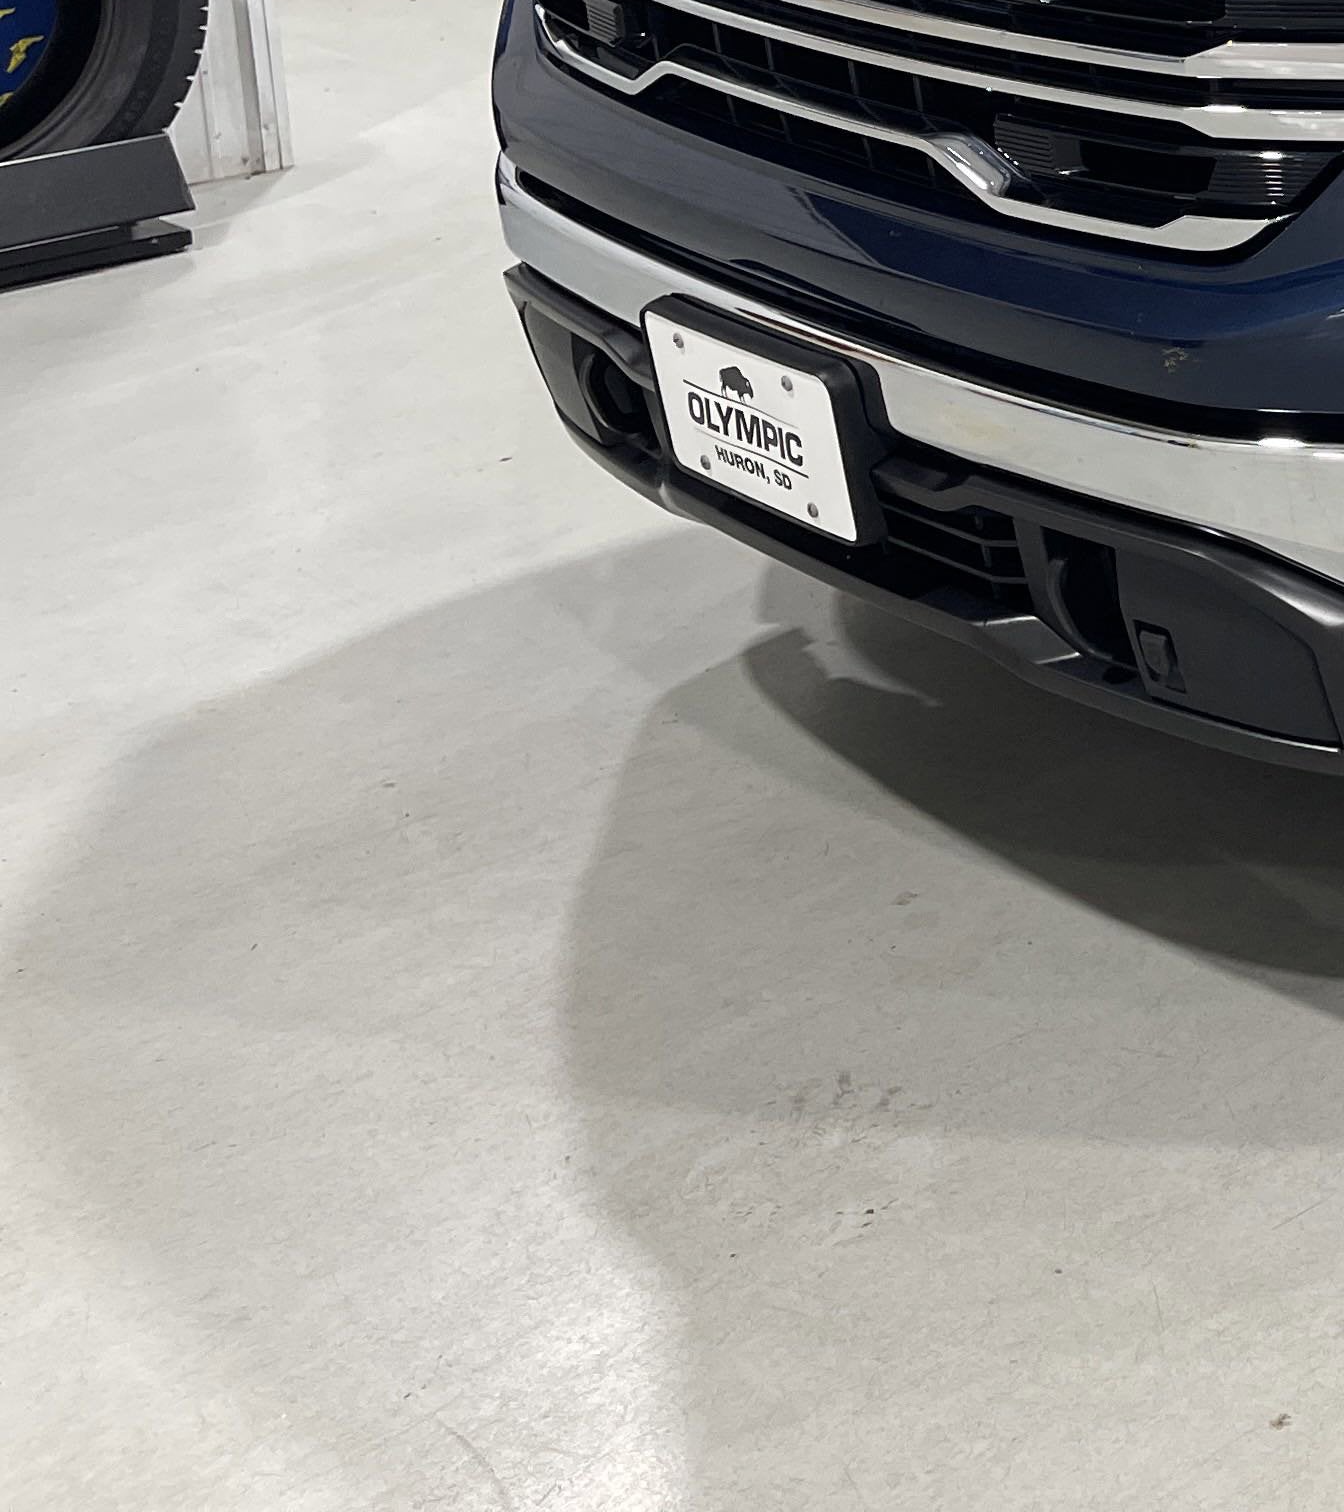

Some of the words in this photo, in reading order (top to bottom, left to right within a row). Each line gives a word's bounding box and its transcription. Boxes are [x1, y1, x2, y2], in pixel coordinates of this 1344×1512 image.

[687, 391, 803, 467] OLYMPIC
[715, 445, 771, 485] HURON,
[774, 469, 792, 490] SD
